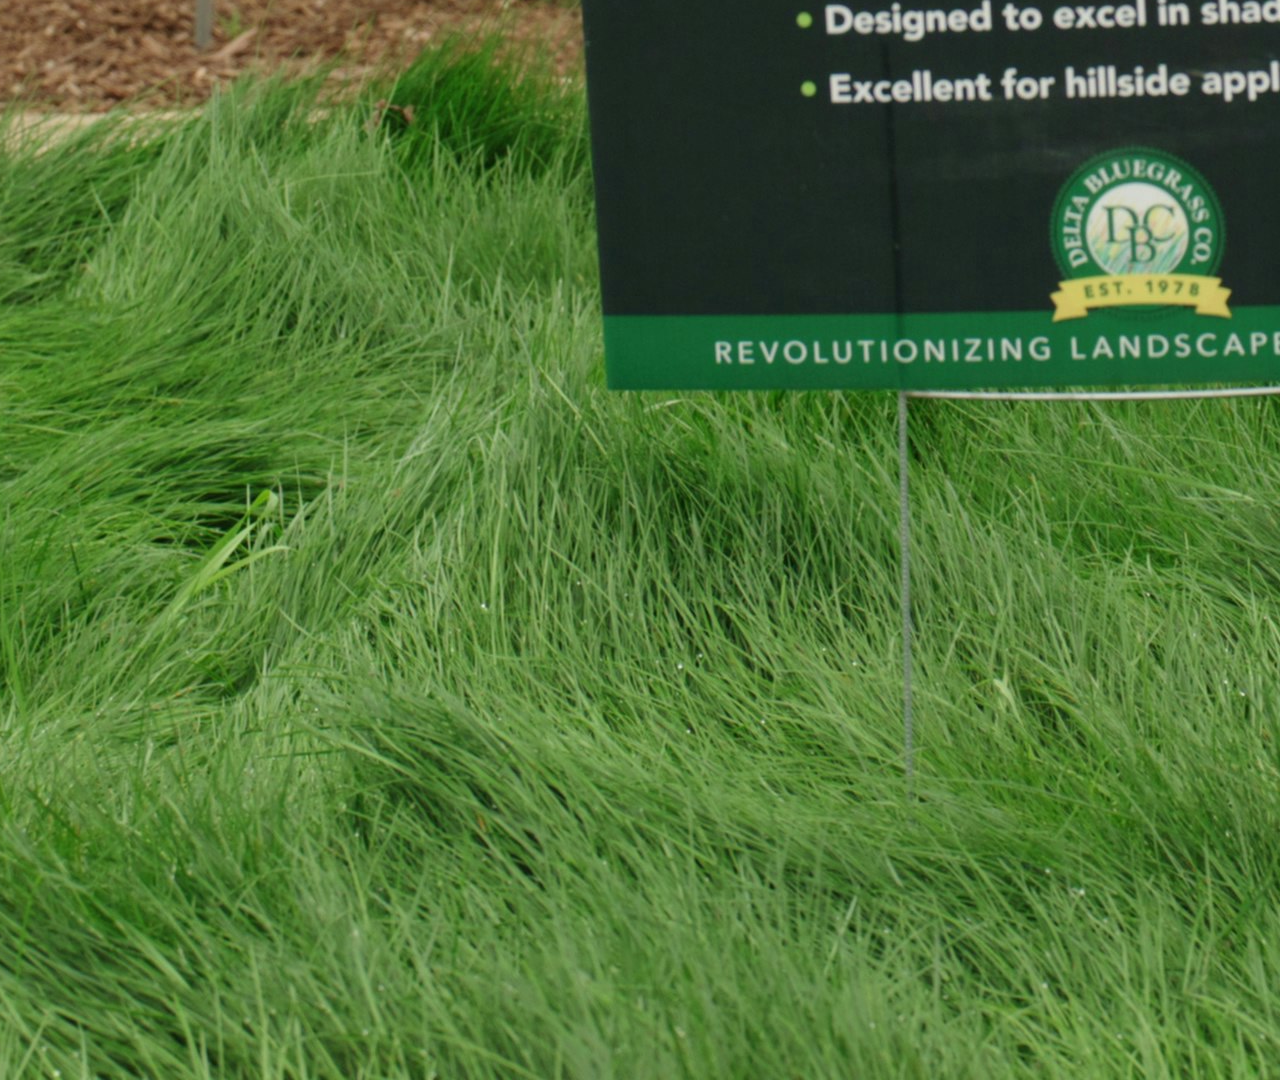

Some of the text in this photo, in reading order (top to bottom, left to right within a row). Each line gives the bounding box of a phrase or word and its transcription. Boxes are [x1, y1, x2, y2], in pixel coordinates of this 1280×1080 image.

[1001, 3, 1043, 31] to
[829, 70, 992, 104] Excellent
[1001, 68, 1056, 101] for
[1064, 63, 1191, 98] hillside
[1063, 159, 1212, 268] DELTA BLUEGRASS CO.
[1084, 280, 1200, 299] EST. 1978
[715, 337, 1050, 363] REVOLUTIONIZING
